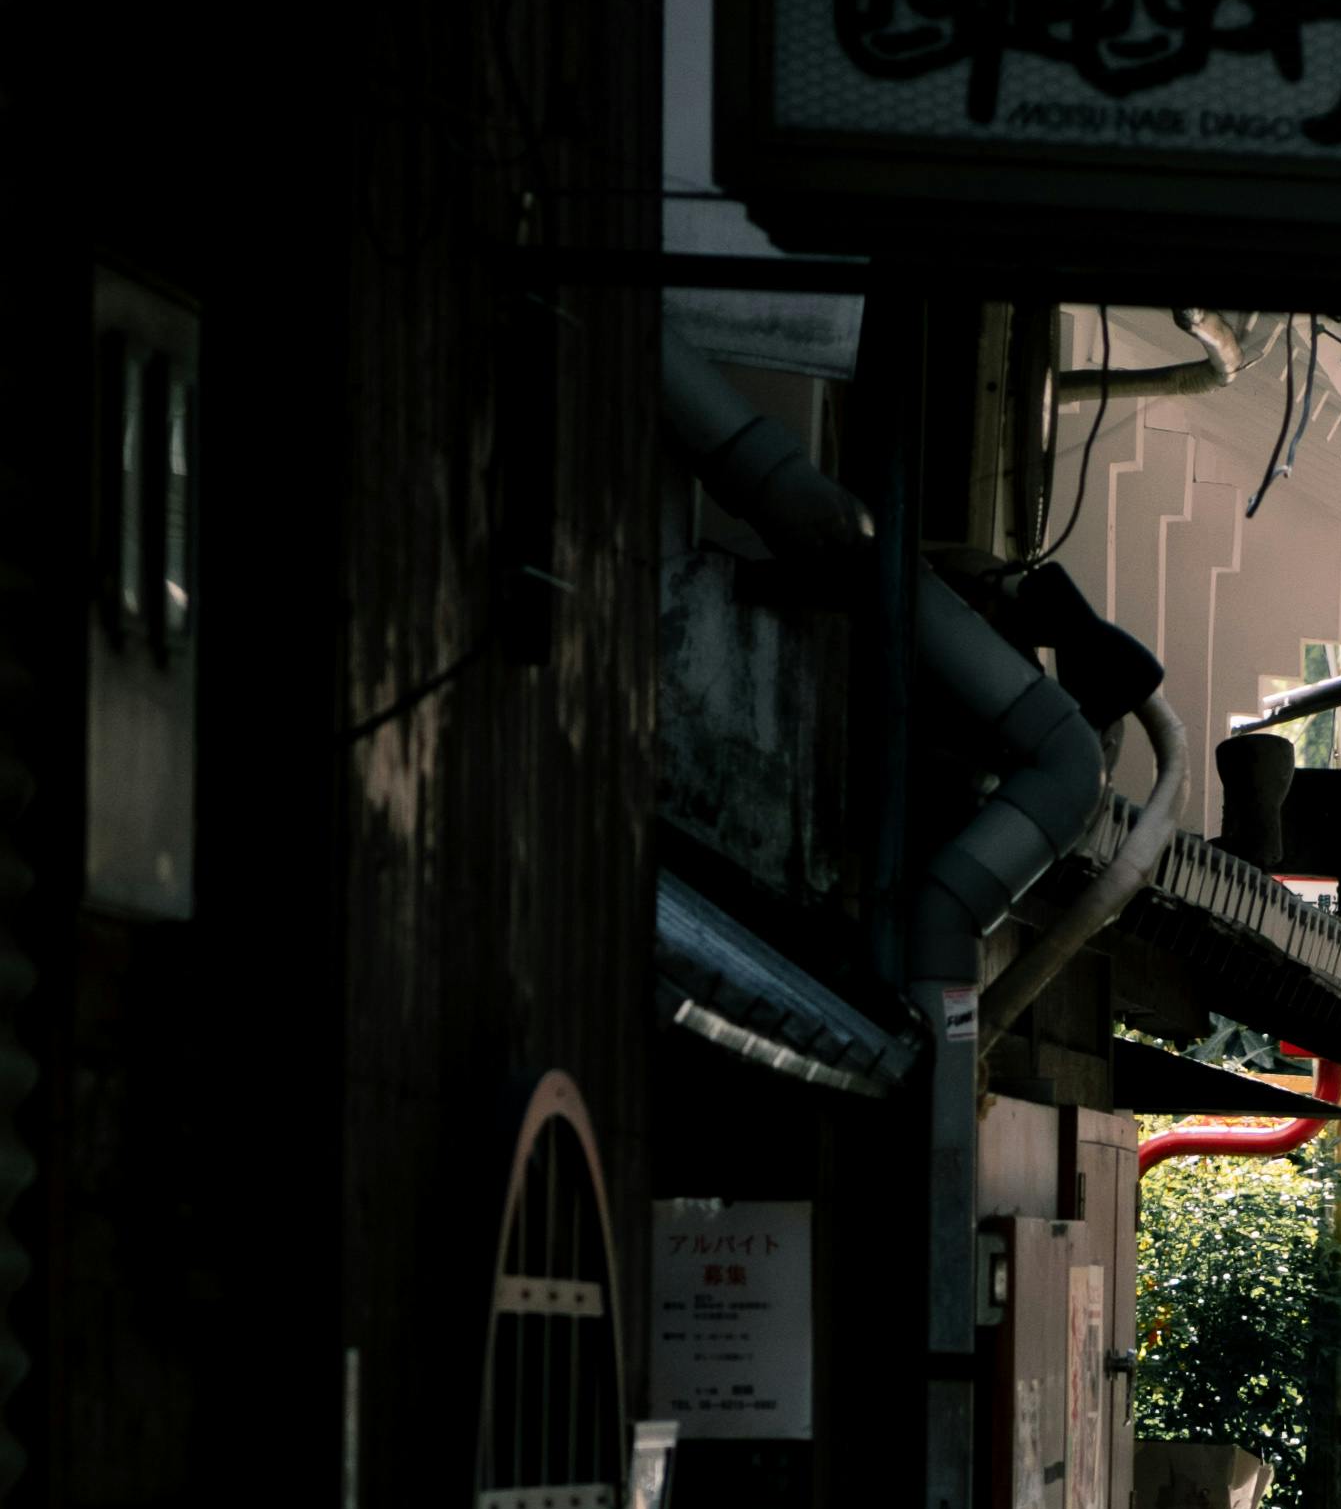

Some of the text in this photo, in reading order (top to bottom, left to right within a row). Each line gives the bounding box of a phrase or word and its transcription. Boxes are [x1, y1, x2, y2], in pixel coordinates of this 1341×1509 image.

[669, 1234, 778, 1255] アルバイト
